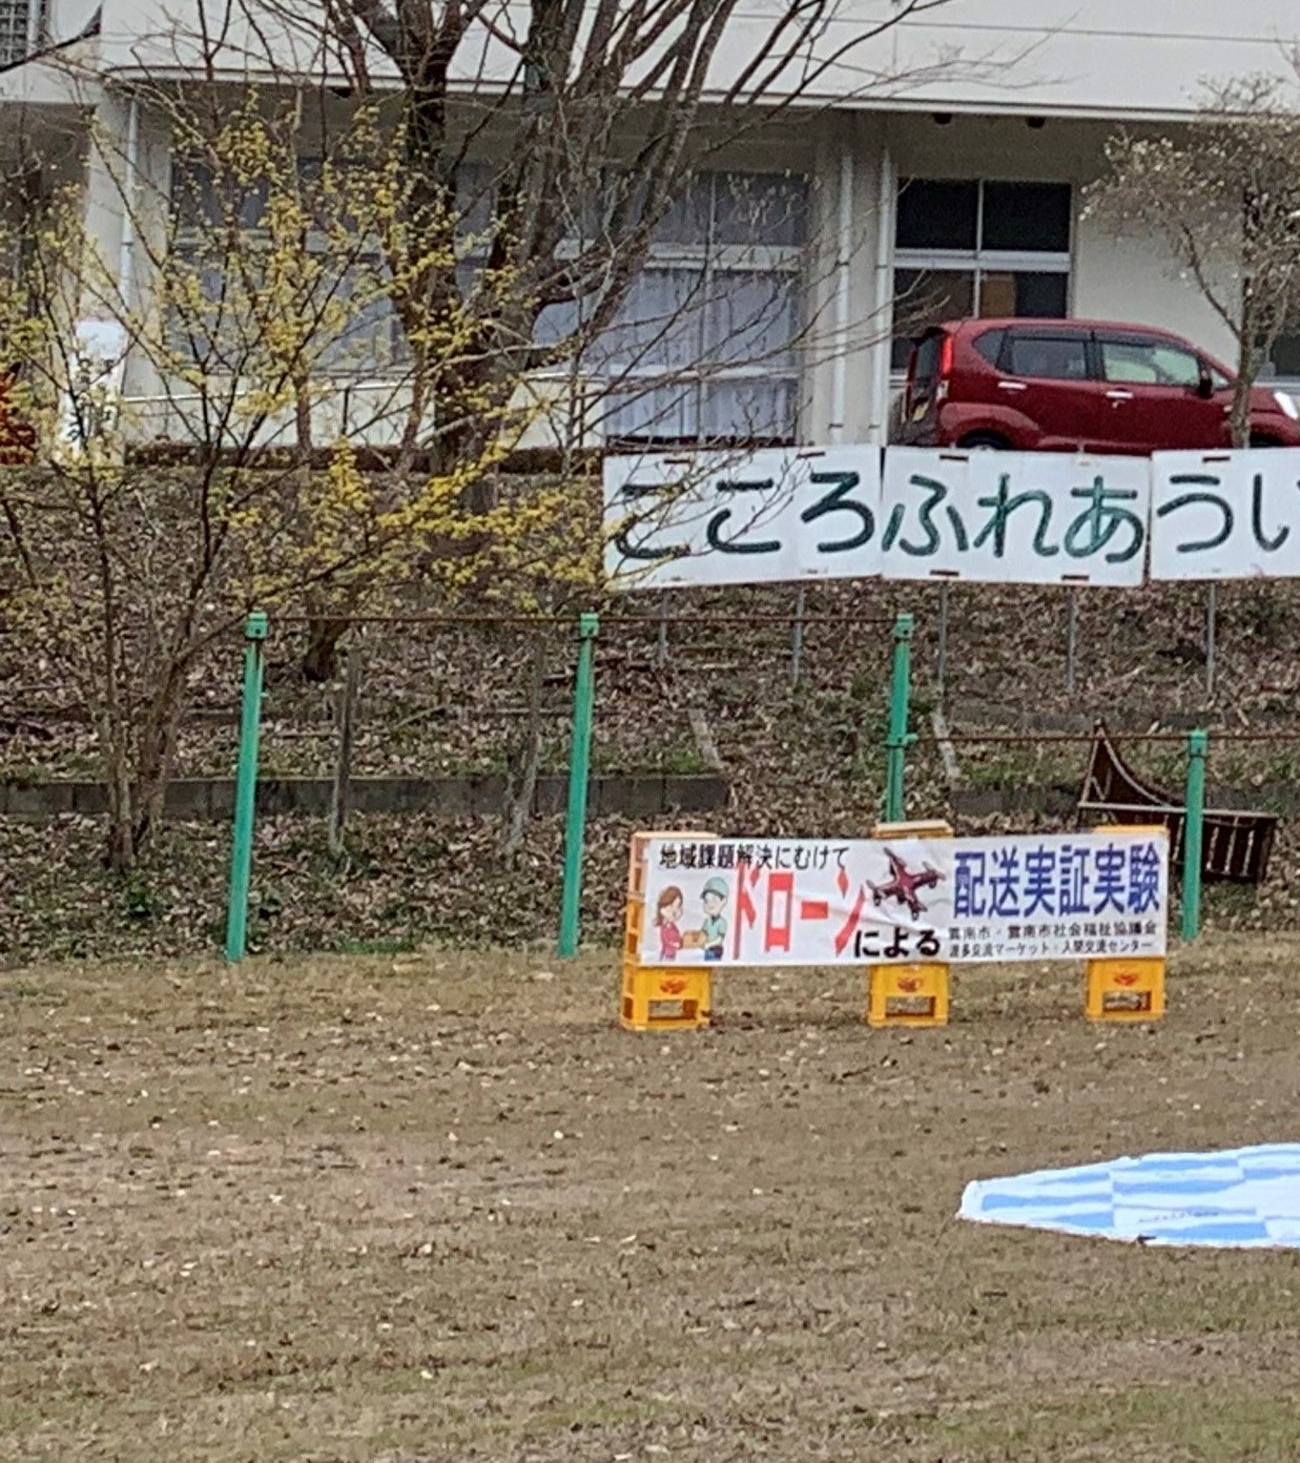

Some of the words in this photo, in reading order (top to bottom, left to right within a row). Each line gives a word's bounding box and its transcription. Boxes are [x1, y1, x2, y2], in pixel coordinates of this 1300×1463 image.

[658, 843, 850, 870] 地域課題解決にむけて
[731, 861, 867, 961] ドローン
[853, 926, 941, 958] による
[953, 841, 1161, 919] 配送実証実験
